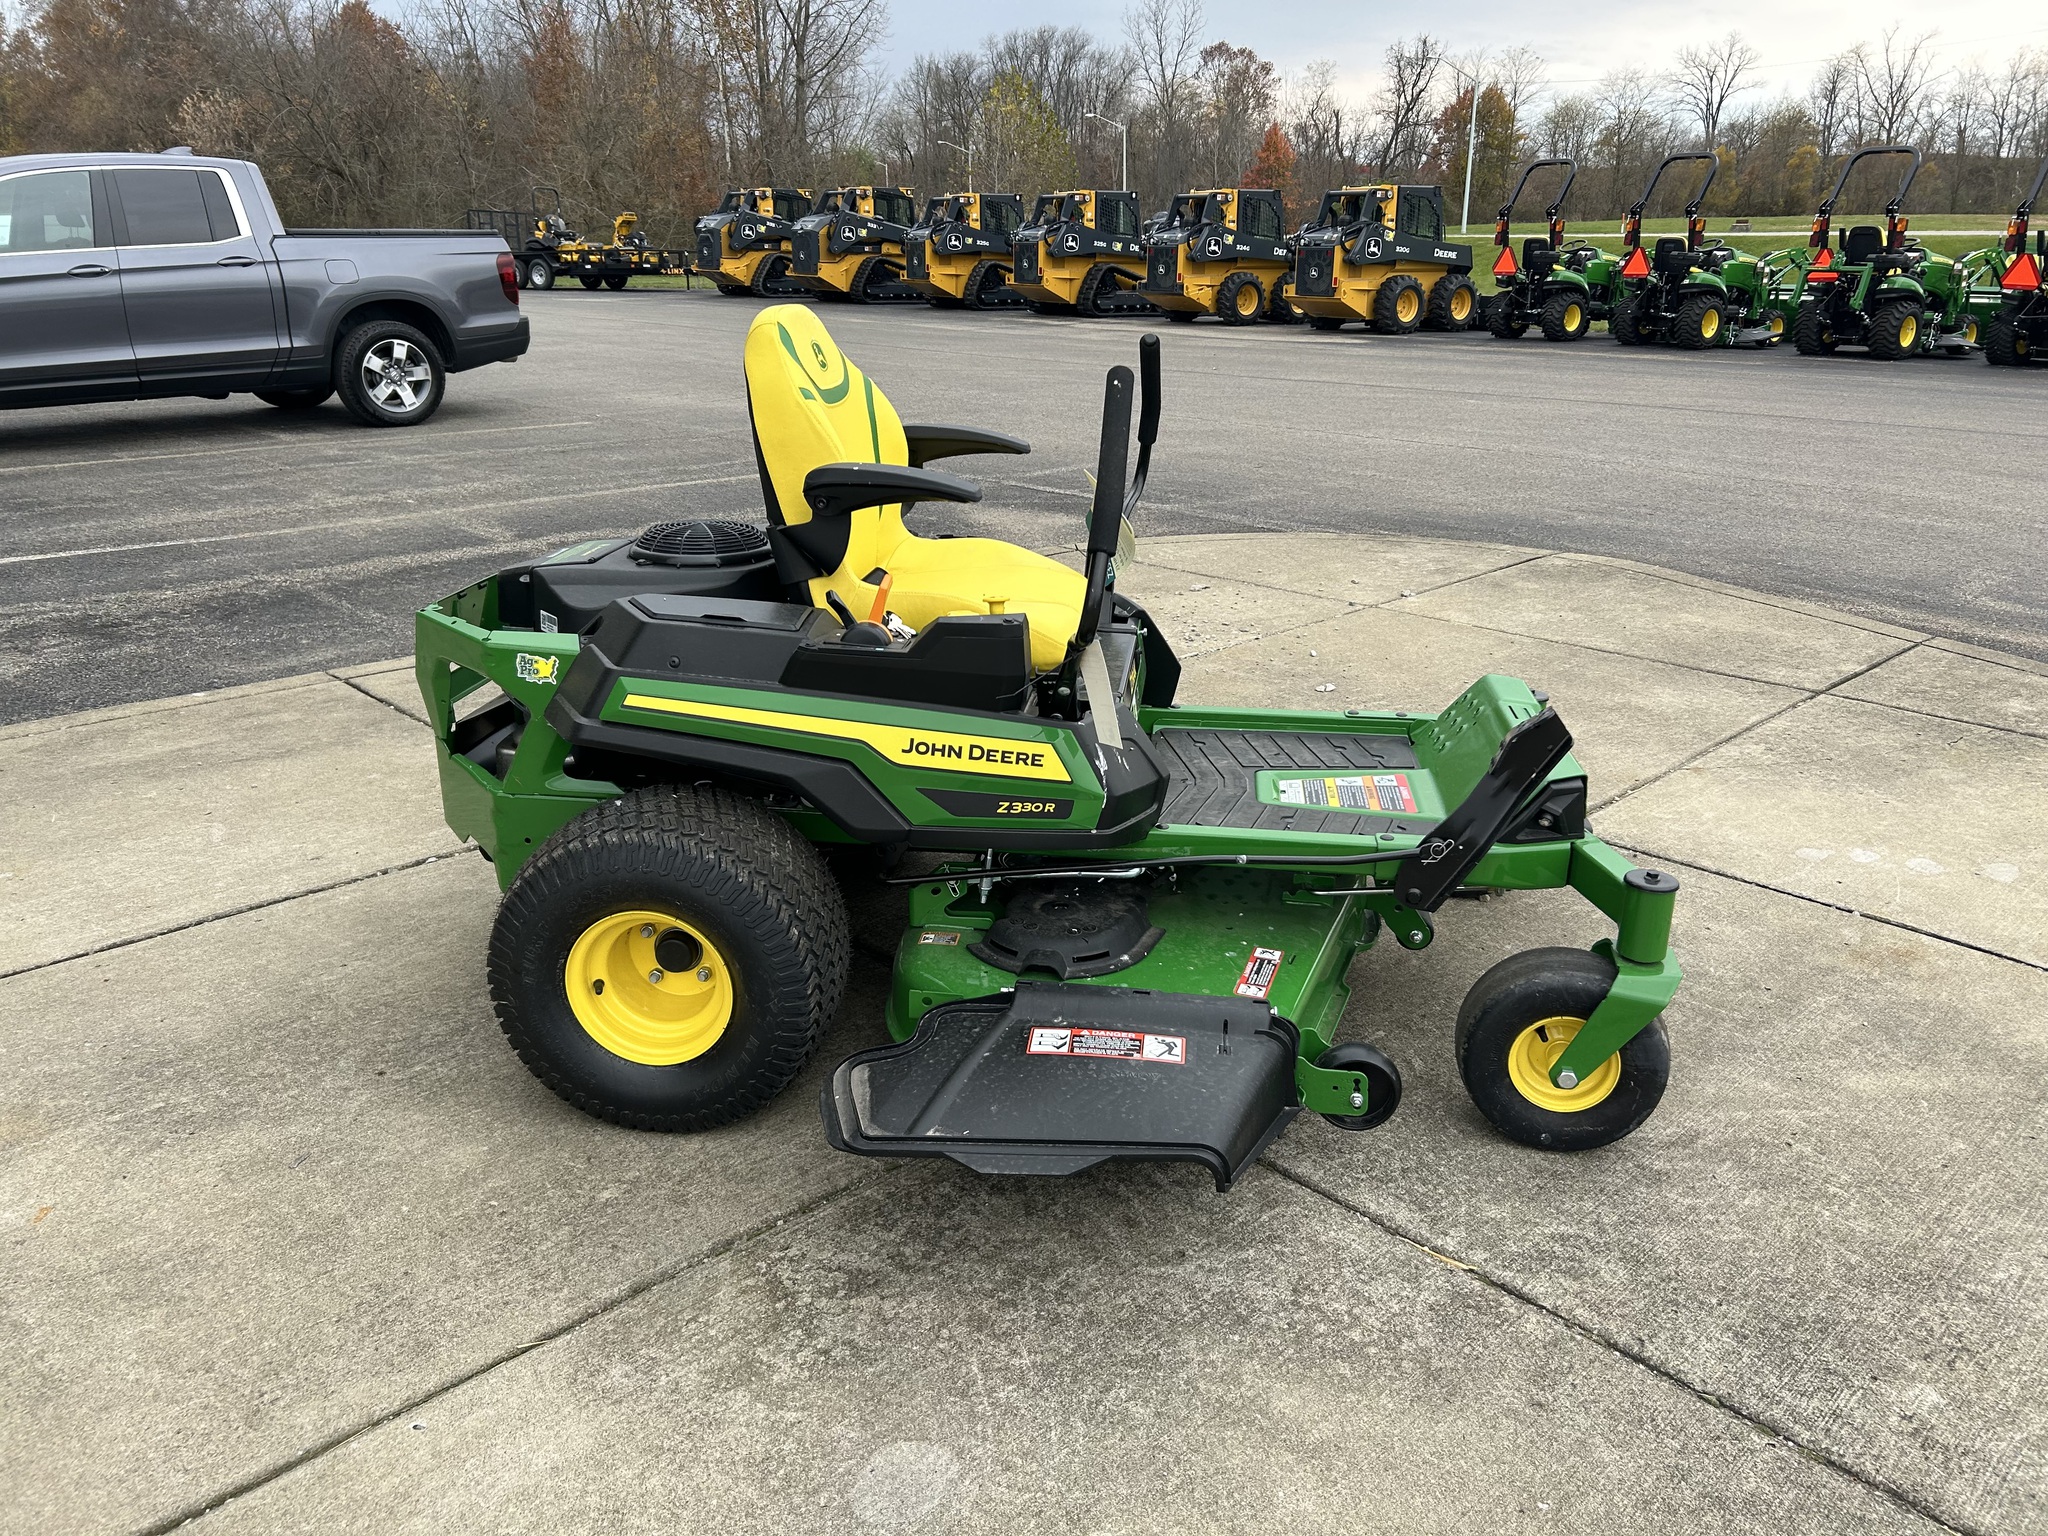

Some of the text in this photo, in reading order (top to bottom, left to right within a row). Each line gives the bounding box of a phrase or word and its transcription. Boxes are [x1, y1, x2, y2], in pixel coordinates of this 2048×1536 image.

[1433, 248, 1459, 259] DEERE
[667, 267, 685, 275] LINX
[519, 655, 538, 667] Ag-
[519, 665, 540, 675] Pro
[901, 737, 1045, 768] JOHN DEERE
[996, 800, 1056, 814] Z330R
[1091, 1030, 1136, 1039] DANGER
